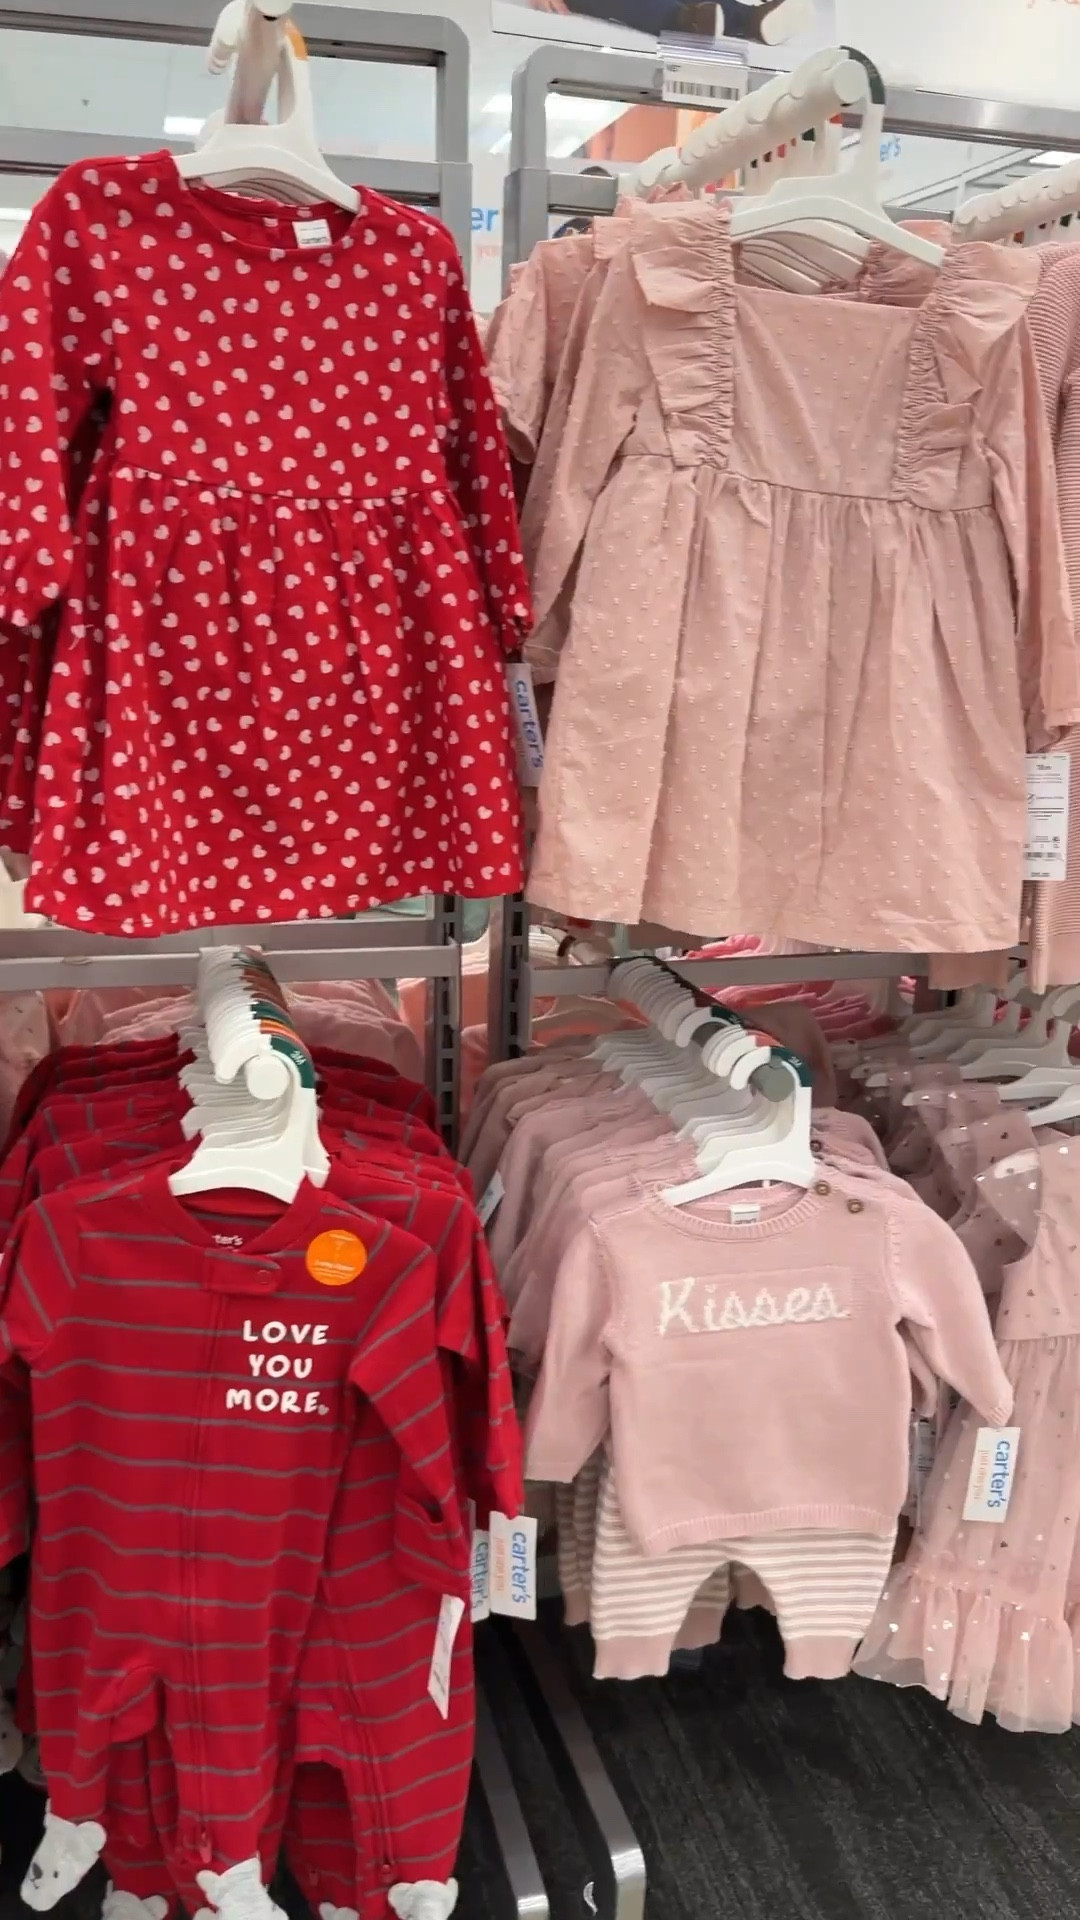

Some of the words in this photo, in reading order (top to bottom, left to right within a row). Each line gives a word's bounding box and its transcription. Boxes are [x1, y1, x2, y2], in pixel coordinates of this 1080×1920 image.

[516, 680, 544, 768] carter's
[243, 1320, 329, 1345] LOVE
[658, 1276, 851, 1336] Kisses
[249, 1354, 313, 1378] YOU
[987, 1440, 1010, 1508] carter's
[511, 1532, 532, 1604] carter's
